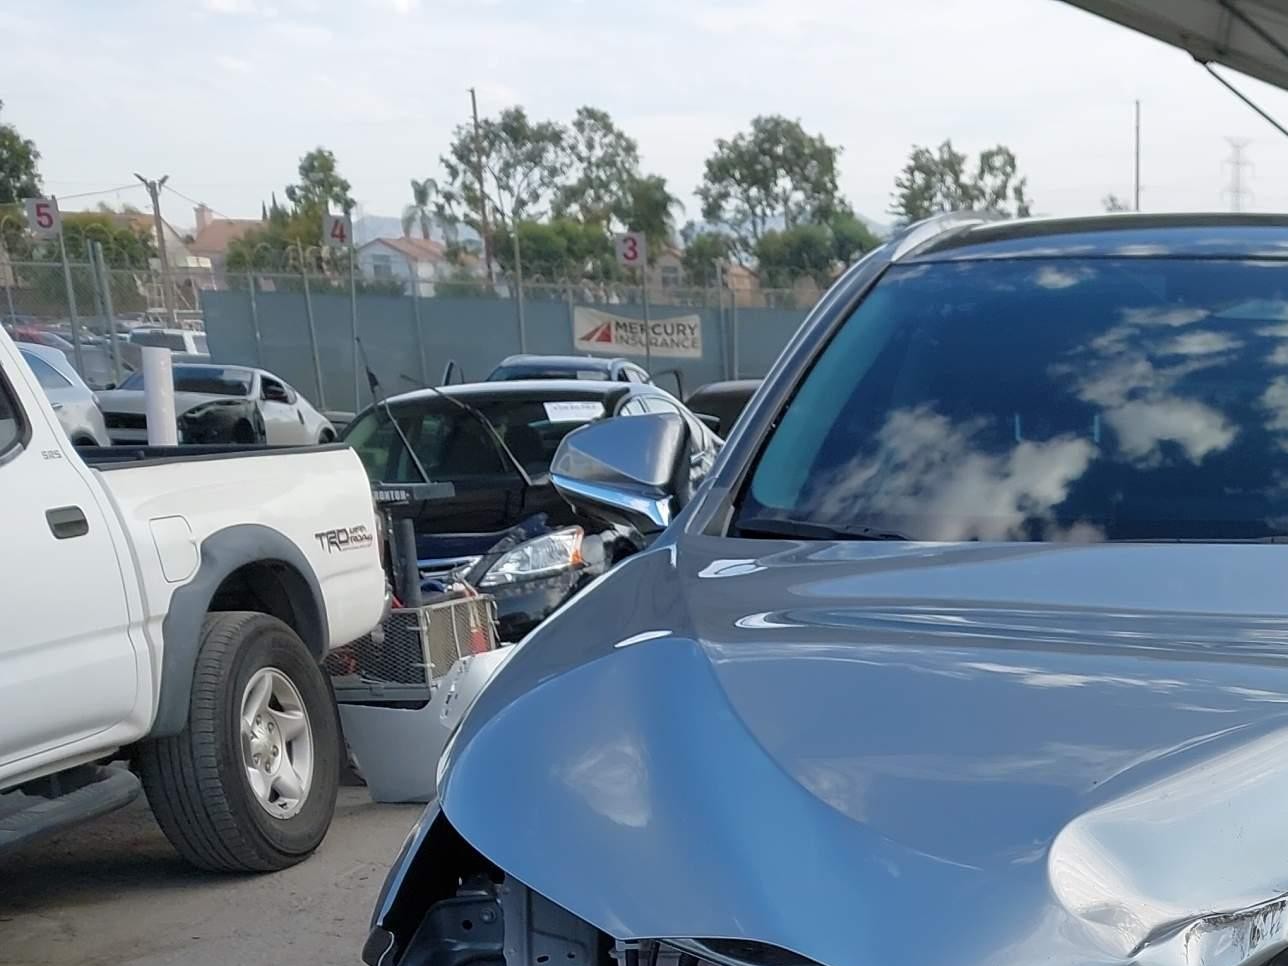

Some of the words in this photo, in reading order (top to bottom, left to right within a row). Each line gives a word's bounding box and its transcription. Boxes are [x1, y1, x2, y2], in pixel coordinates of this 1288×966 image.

[36, 203, 54, 229] 5
[330, 219, 347, 244] 4
[623, 236, 638, 261] 3
[315, 528, 349, 554] TRD
